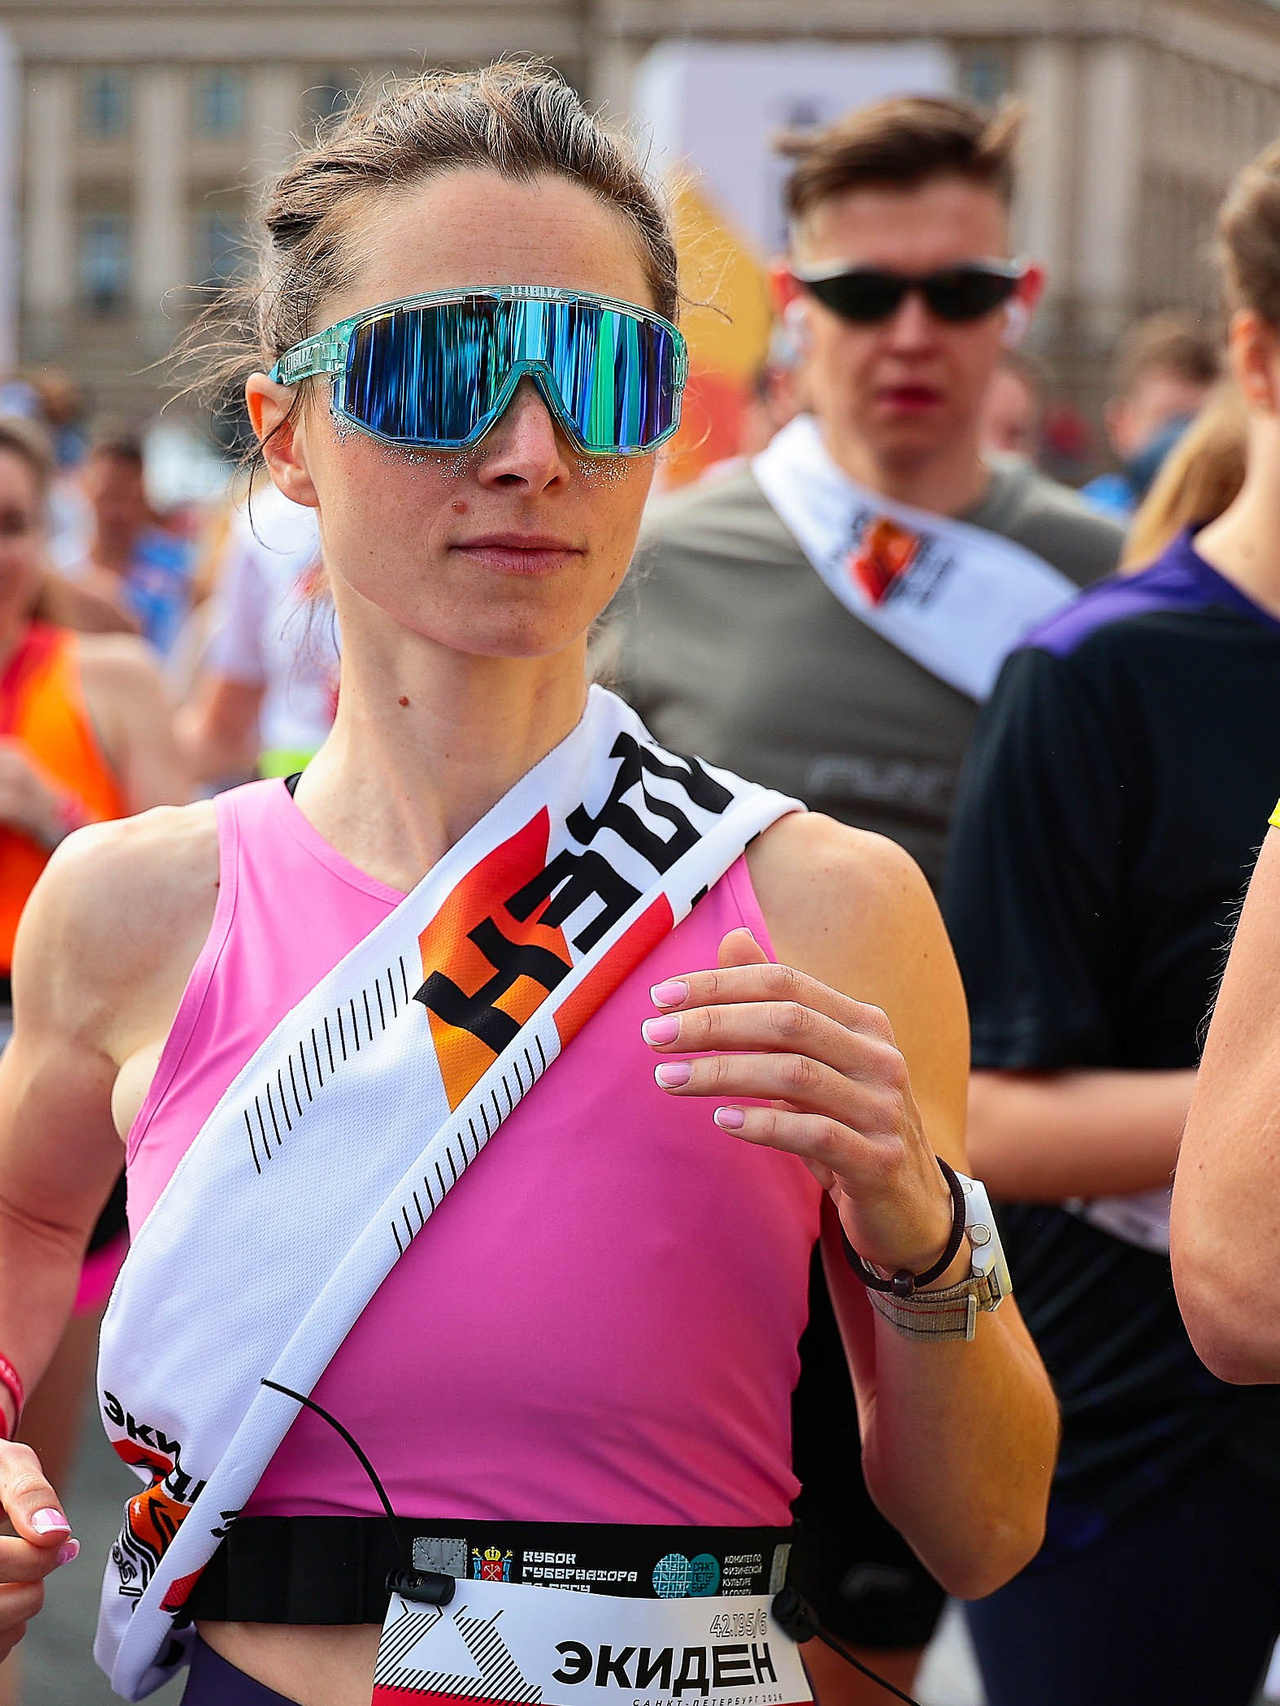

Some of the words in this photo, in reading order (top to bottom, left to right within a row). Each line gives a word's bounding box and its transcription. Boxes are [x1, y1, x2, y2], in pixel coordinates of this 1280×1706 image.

[103, 1390, 208, 1504] ЭКИД
[523, 1550, 577, 1565] КУБОК
[522, 1566, 638, 1582] ГУБЕРНАТОРА
[709, 1608, 768, 1639] 42.195/6
[551, 1640, 778, 1698] ЭКИДЕН
